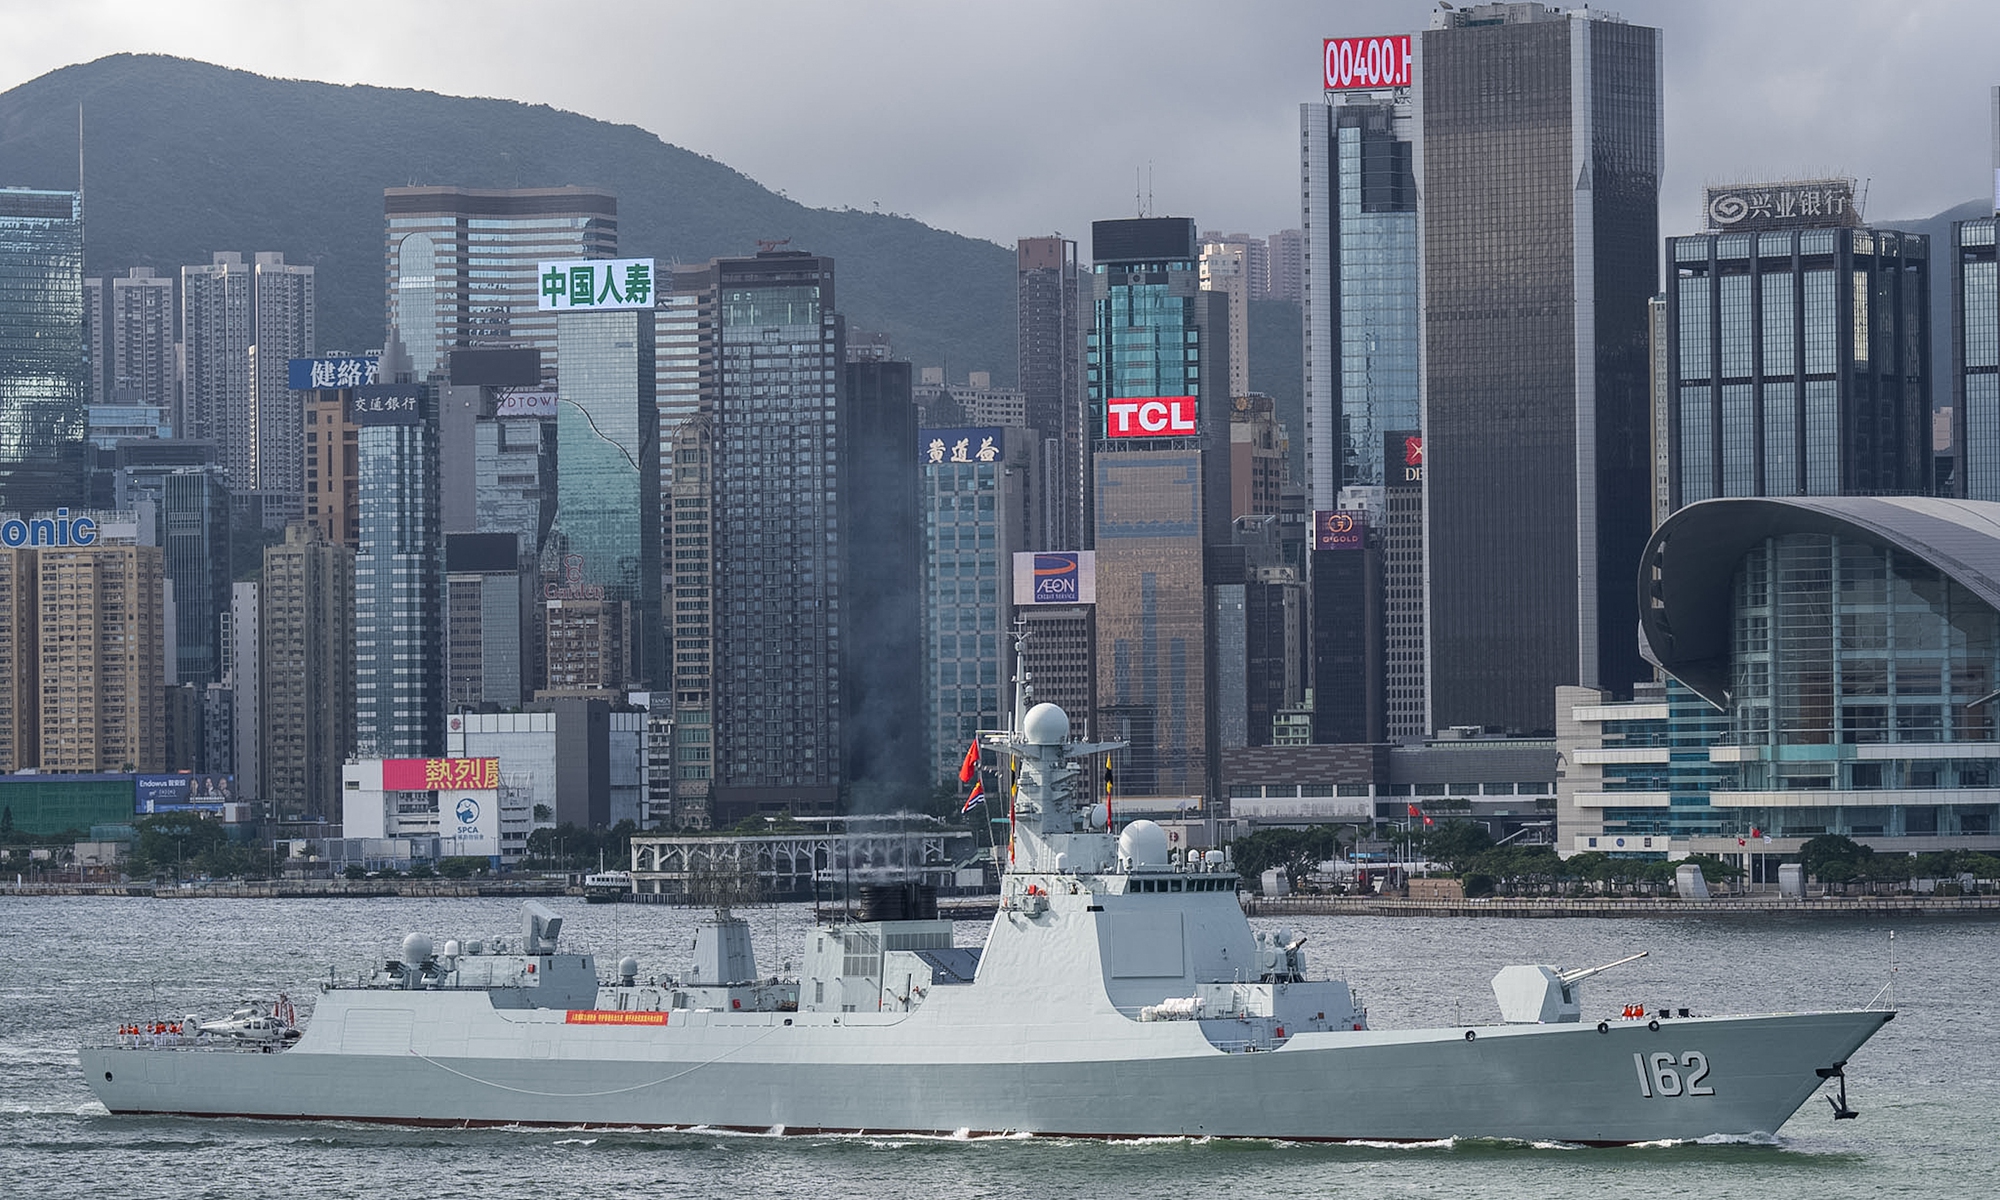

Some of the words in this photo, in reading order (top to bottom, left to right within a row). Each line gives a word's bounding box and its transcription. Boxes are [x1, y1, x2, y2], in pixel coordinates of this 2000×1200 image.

[1750, 189, 1846, 219] 兴业银行
[542, 264, 651, 307] 中国人寿
[355, 397, 416, 412] 交通銀行
[1109, 402, 1194, 432] TCL
[1, 507, 96, 548] onic
[544, 583, 605, 600] Garden
[457, 826, 479, 834] SPCA
[1633, 1051, 1715, 1098] 162
